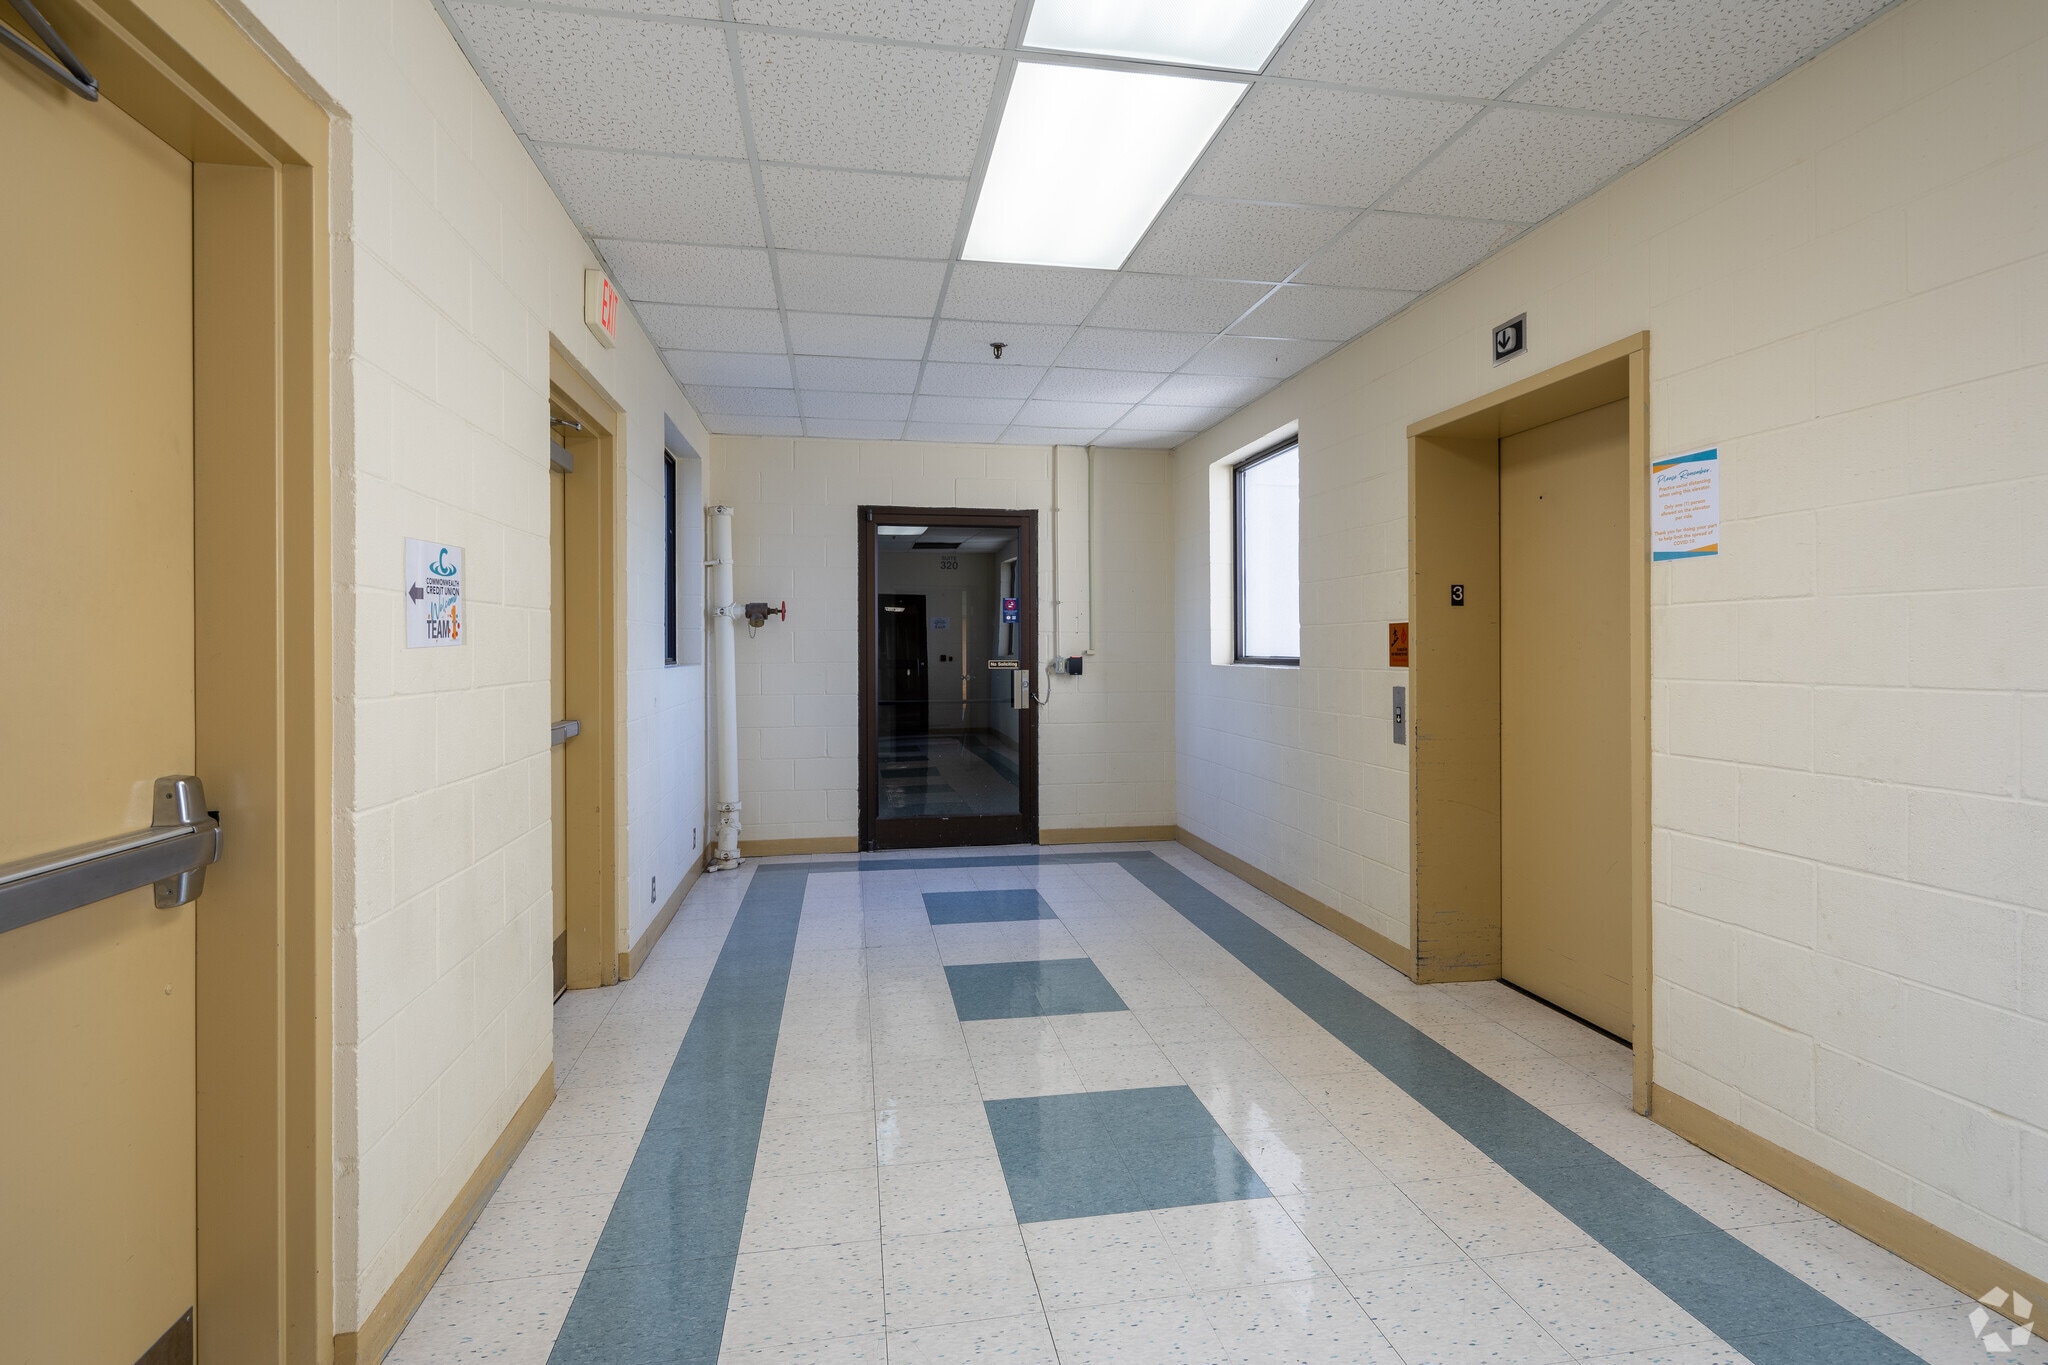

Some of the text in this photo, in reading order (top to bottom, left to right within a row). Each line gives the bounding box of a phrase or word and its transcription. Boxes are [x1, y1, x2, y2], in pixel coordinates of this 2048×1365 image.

[601, 279, 618, 340] EXIT
[1657, 474, 1677, 485] Please
[940, 560, 958, 570] 320
[426, 577, 460, 588] COMMONWEALTH
[426, 585, 460, 597] CREDIT UNION
[1452, 586, 1463, 601] 3
[427, 620, 450, 639] TEAM
